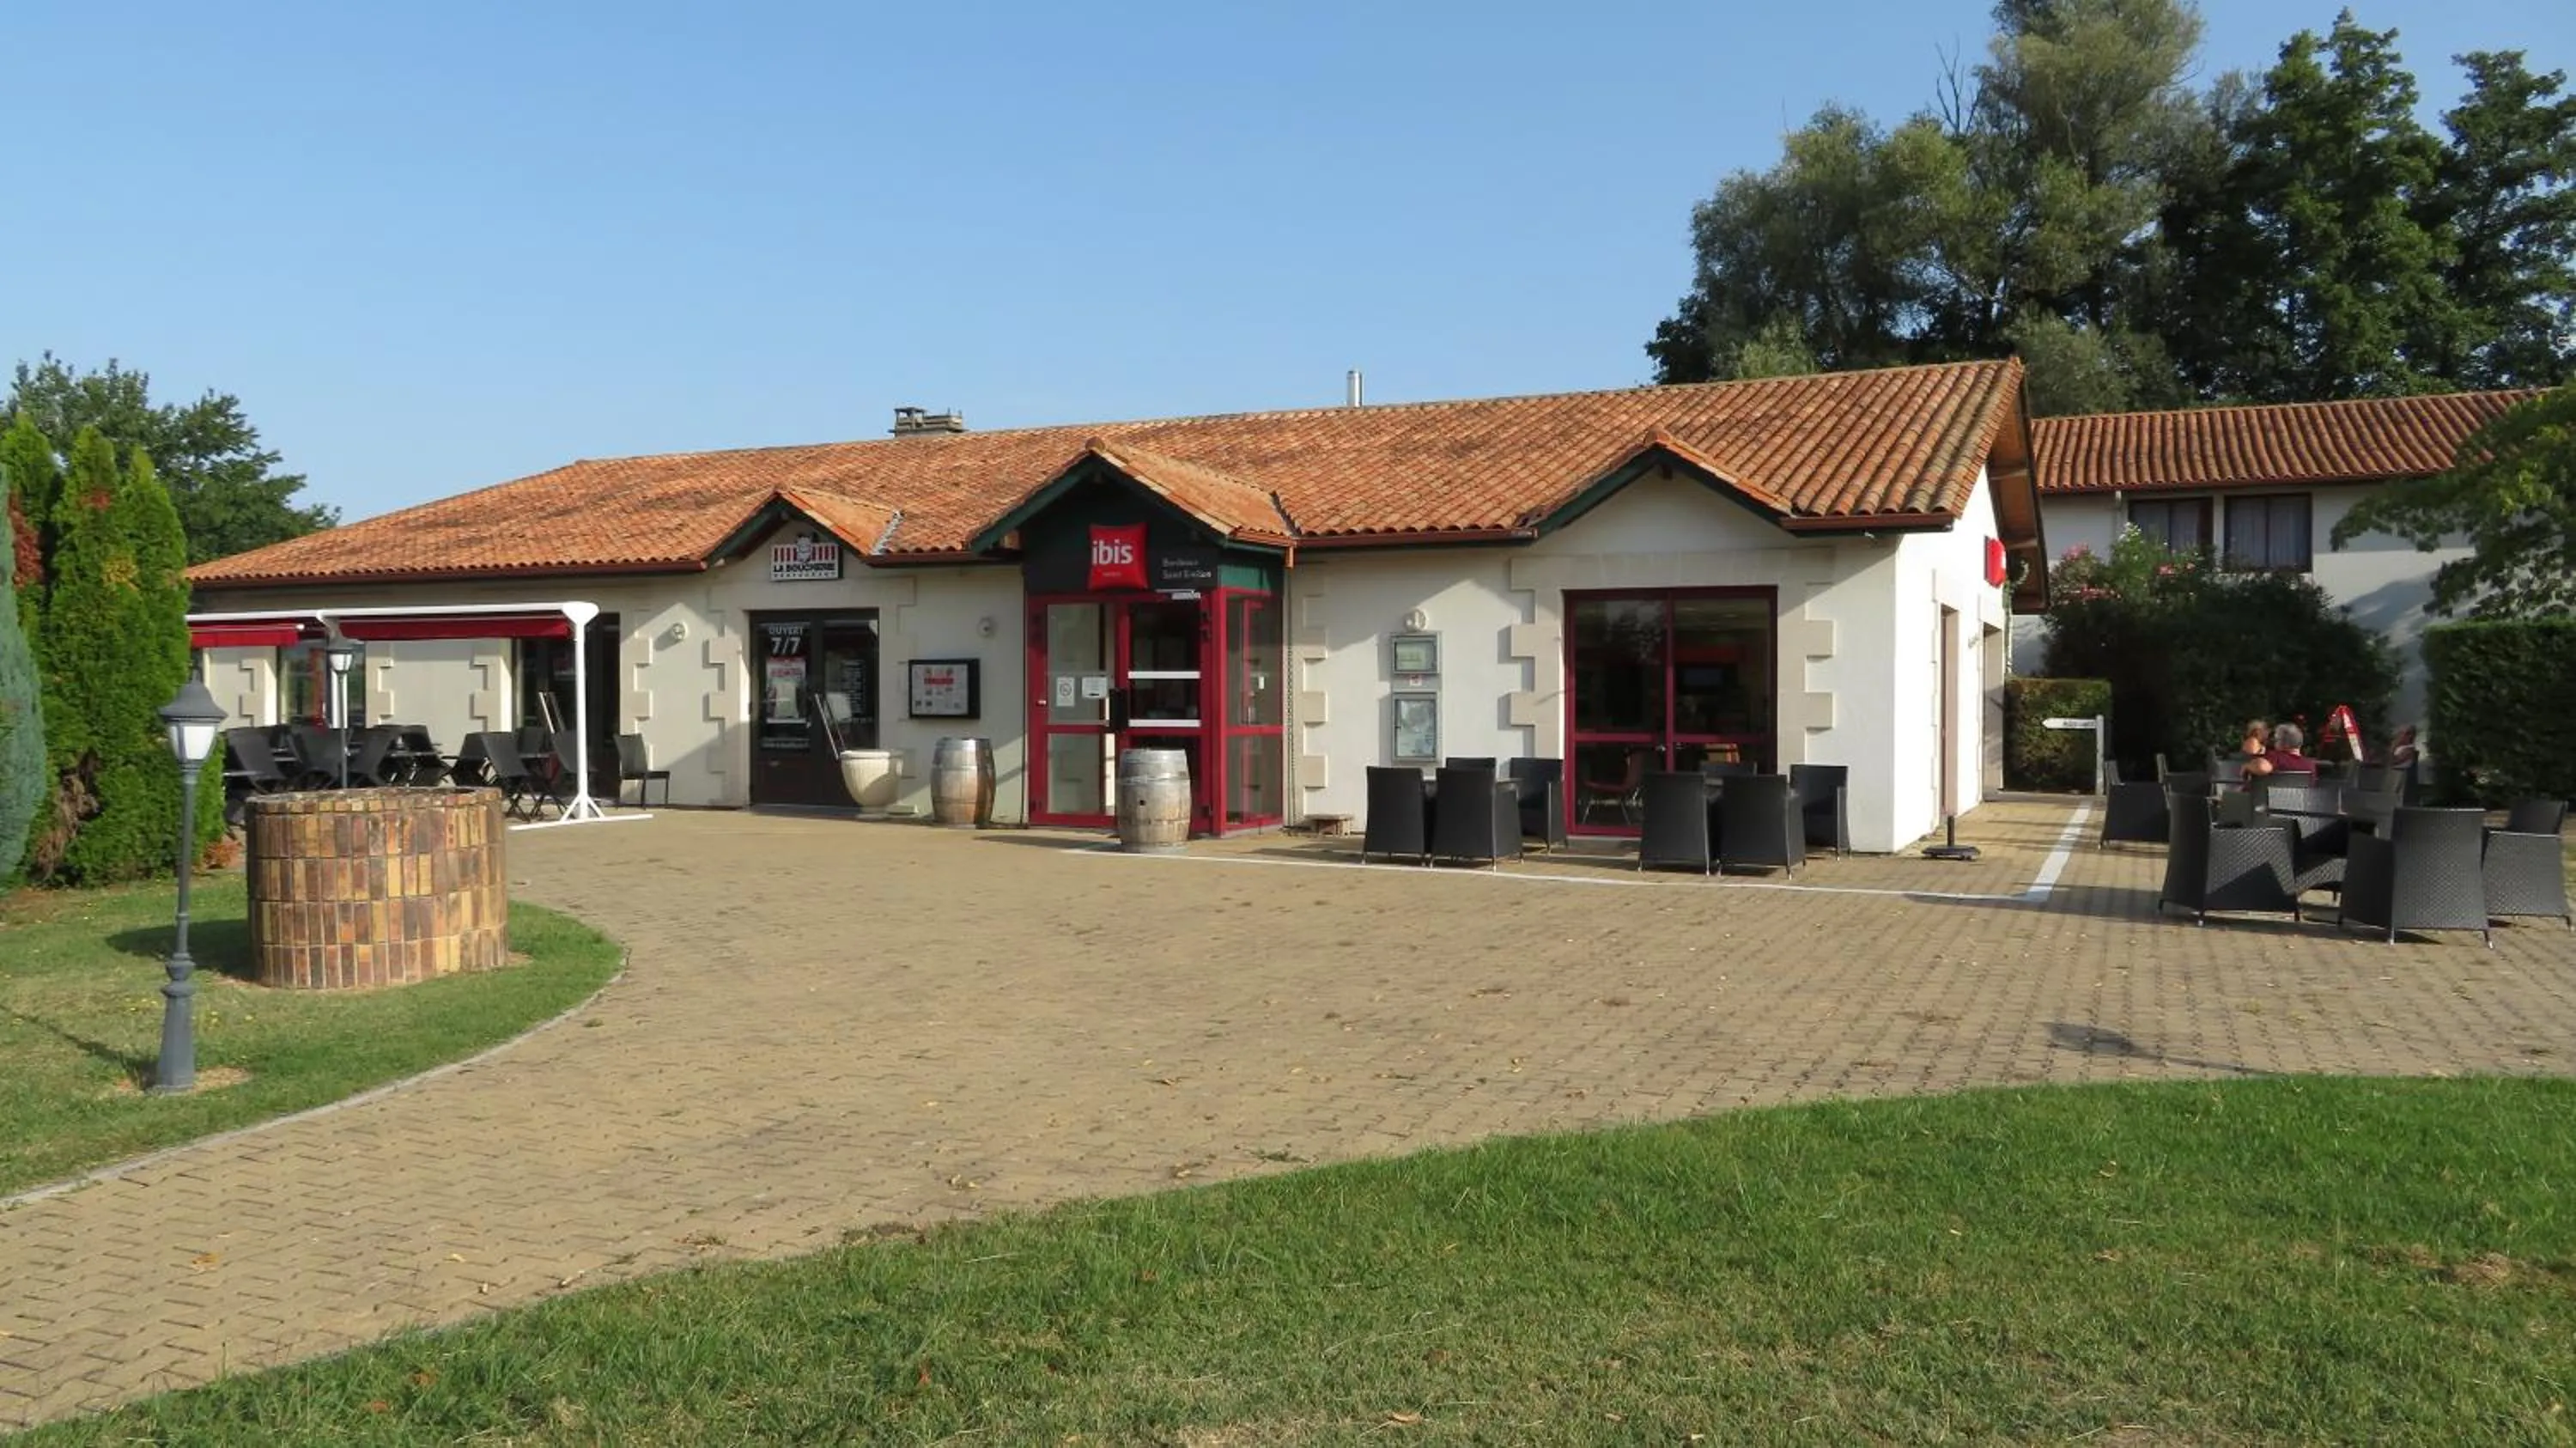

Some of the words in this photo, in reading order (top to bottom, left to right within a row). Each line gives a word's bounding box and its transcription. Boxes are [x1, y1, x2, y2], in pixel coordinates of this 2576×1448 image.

[1091, 539, 1133, 565] ibis
[774, 564, 784, 573] LA
[786, 563, 835, 573] BOUCHERIE
[769, 626, 803, 636] OUVERT
[771, 637, 801, 654] 7/7
